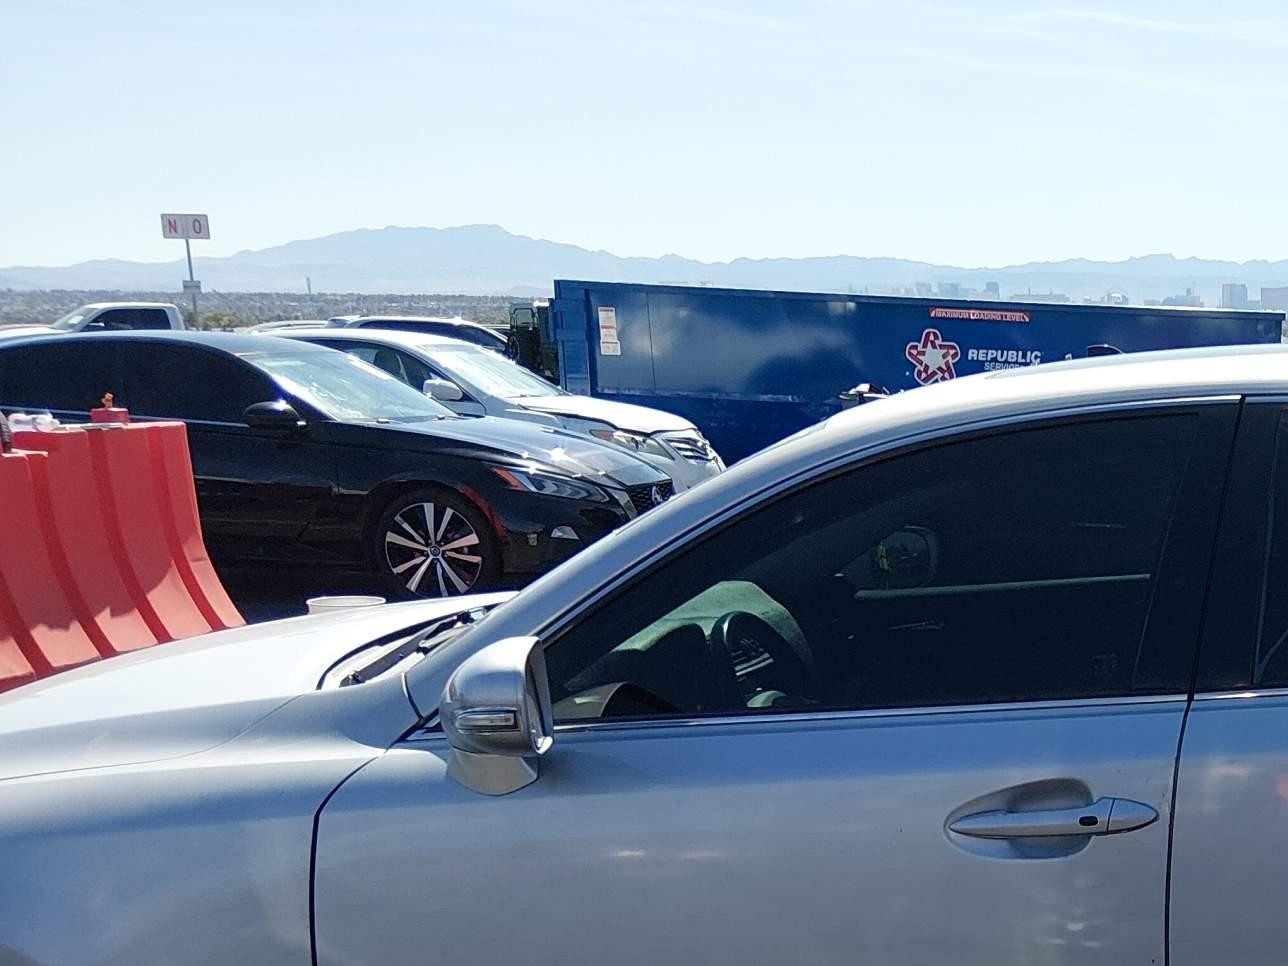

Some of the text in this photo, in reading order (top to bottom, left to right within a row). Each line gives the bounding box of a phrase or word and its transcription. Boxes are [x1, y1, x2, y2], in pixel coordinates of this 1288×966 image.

[167, 218, 202, 234] N O
[936, 310, 1025, 321] MAXIMUM LOADING LEVEL
[967, 348, 1042, 363] REPUBLIC
